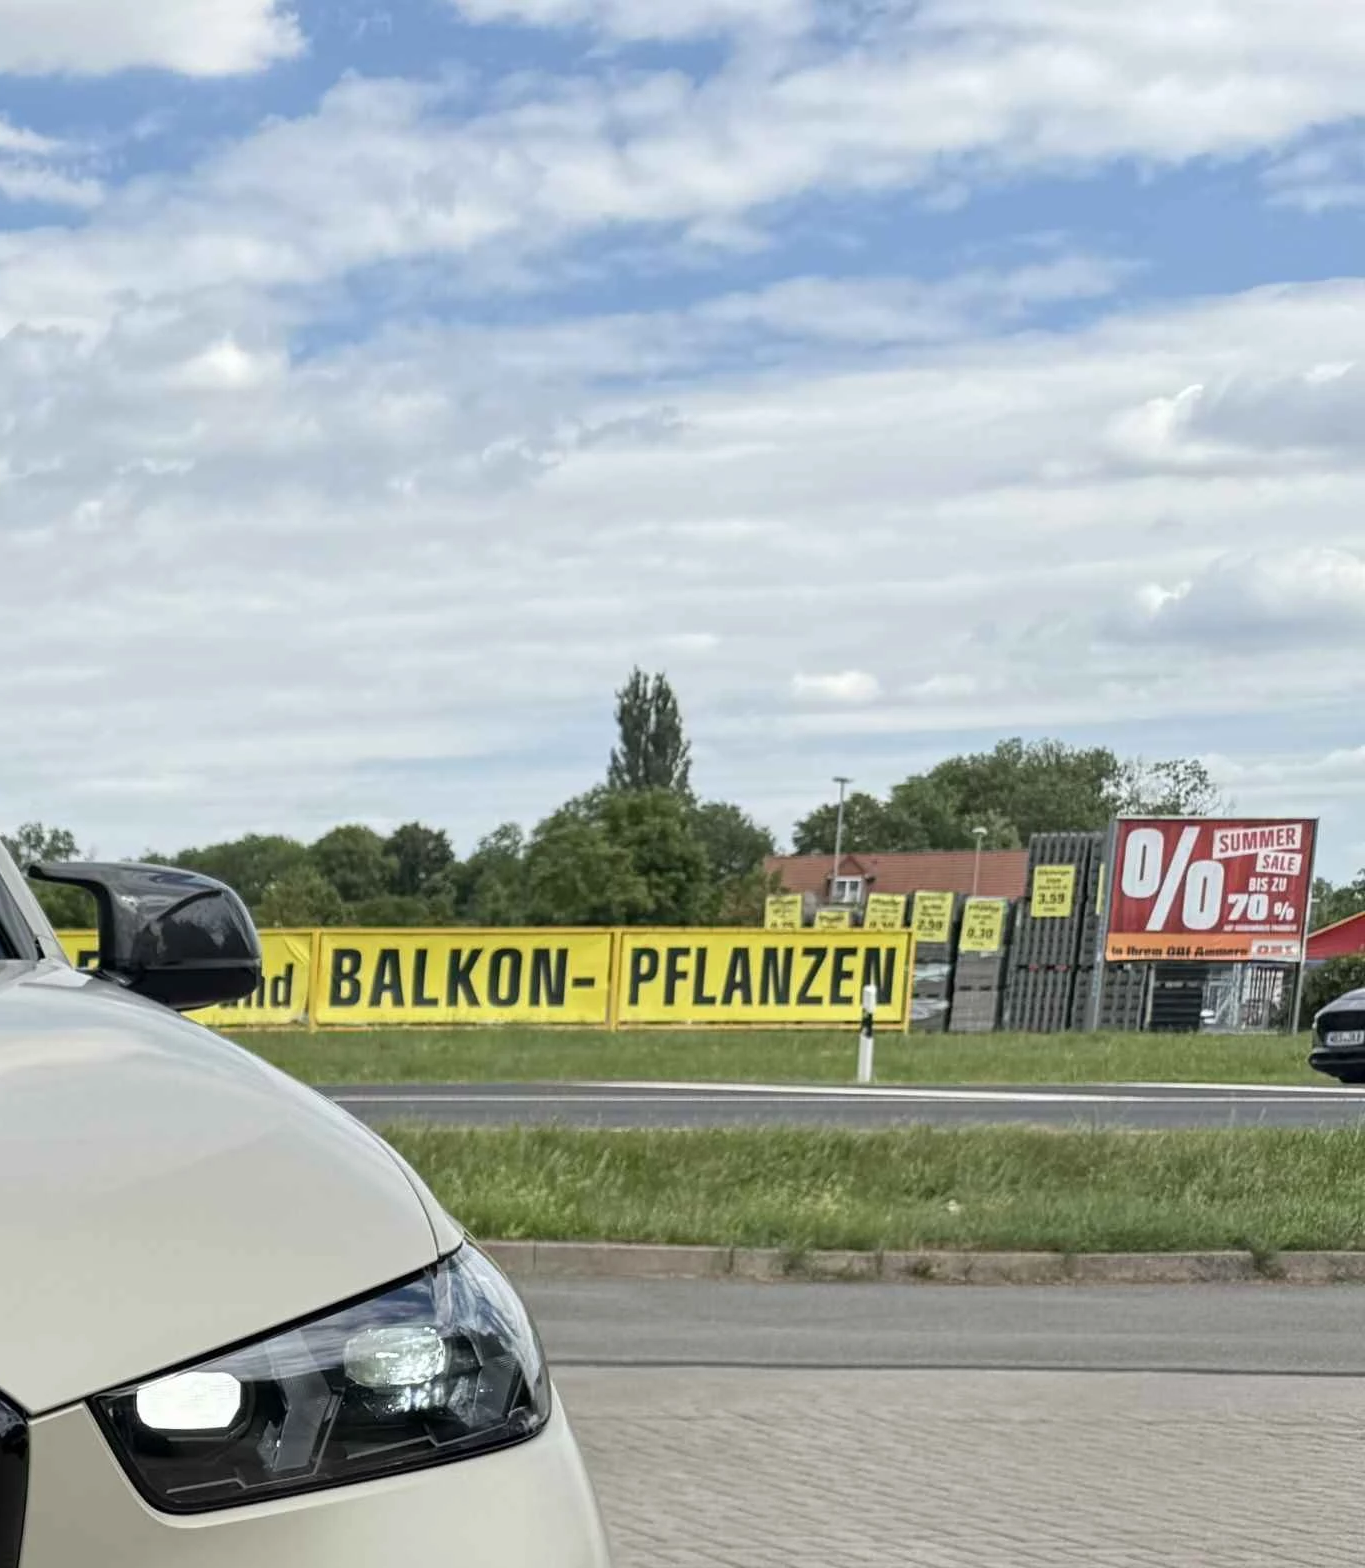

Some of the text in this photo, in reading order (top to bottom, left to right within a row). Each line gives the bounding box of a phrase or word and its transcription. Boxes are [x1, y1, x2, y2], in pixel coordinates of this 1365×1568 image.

[1219, 828, 1296, 853] SUMMER
[1261, 854, 1296, 873] SALE
[1248, 877, 1287, 892] BIS ZU
[1227, 893, 1295, 921] 70 %
[330, 947, 595, 1007] BALKON-
[628, 947, 897, 1006] PFLANZEN
